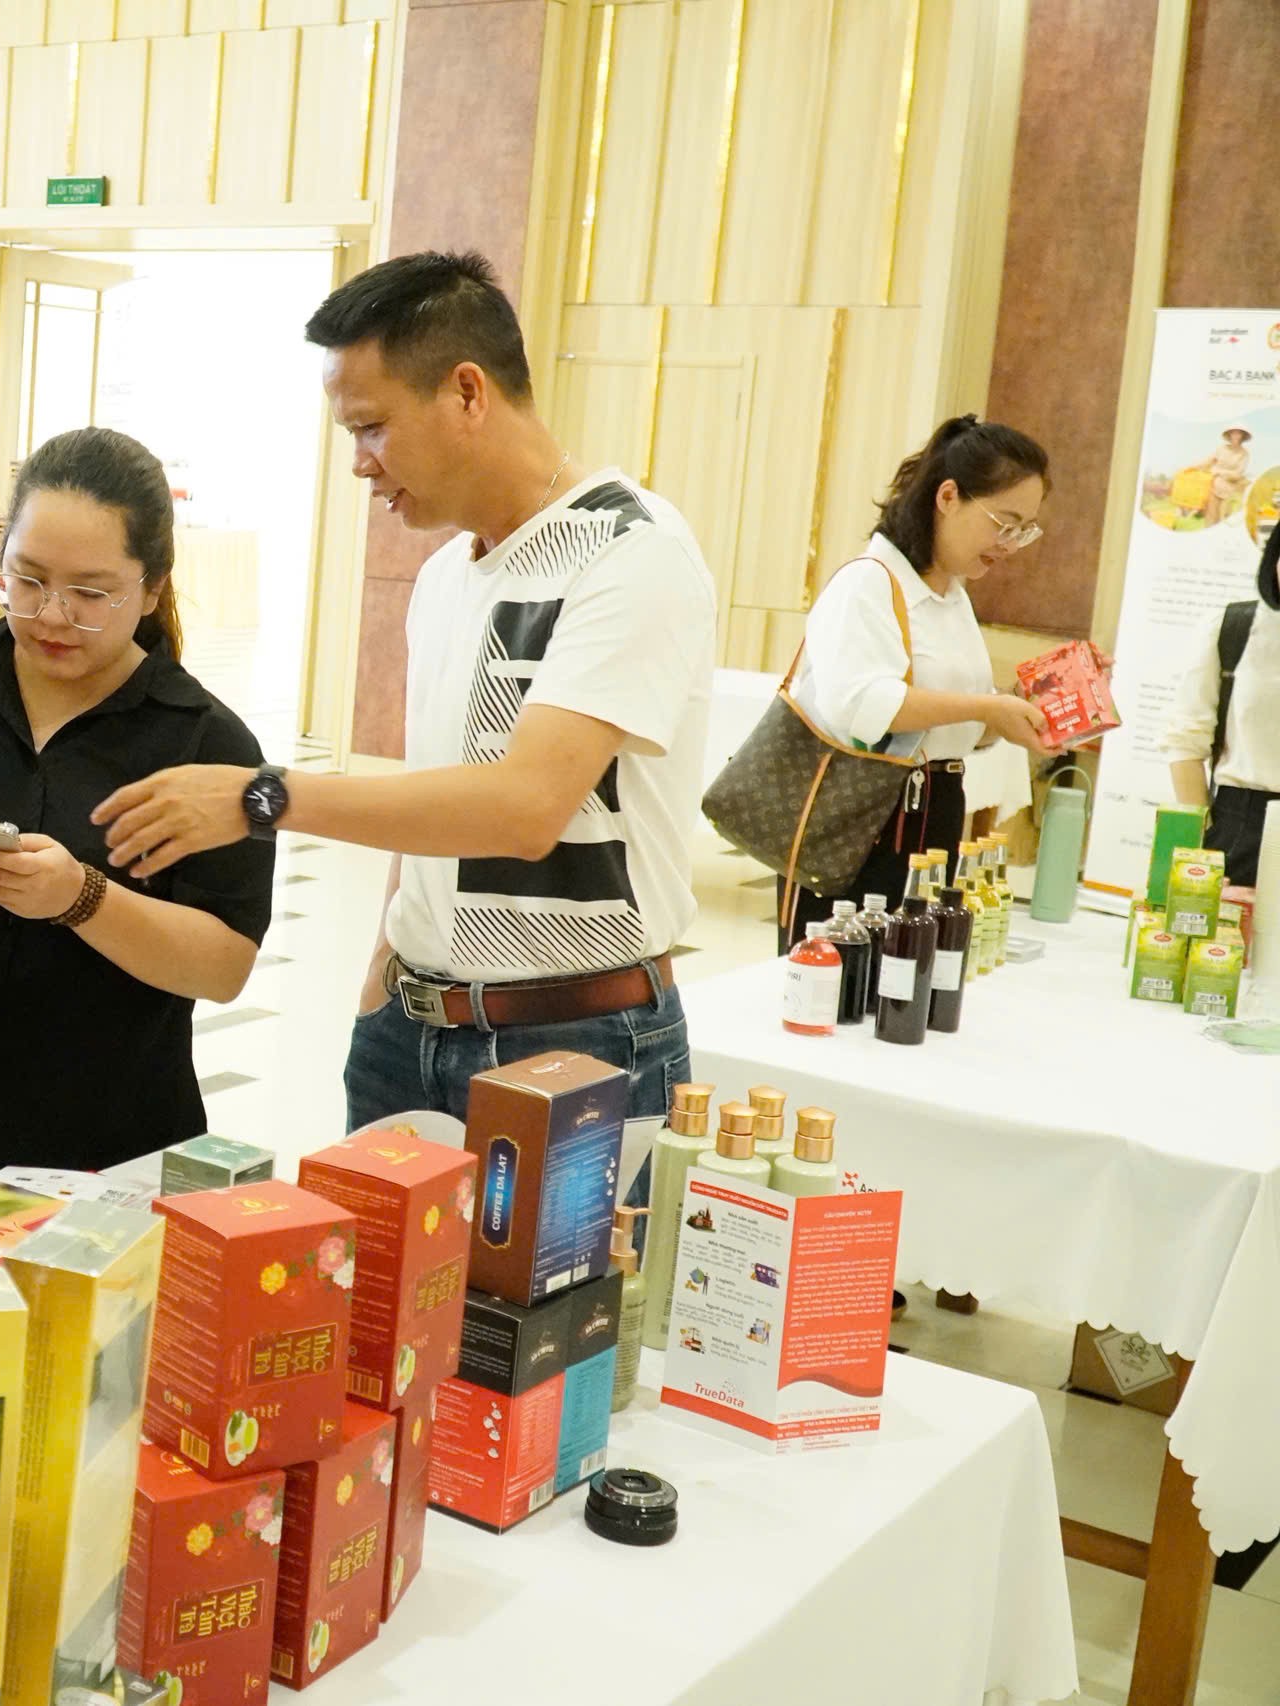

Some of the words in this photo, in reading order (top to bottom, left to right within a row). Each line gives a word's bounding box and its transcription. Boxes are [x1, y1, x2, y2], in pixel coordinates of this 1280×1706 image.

[1208, 370, 1232, 380] BAC
[1246, 371, 1275, 381] BANK
[497, 1153, 508, 1174] LAT
[494, 1176, 505, 1190] DA
[492, 1192, 504, 1231] COFFEE
[694, 1382, 745, 1408] TrueData
